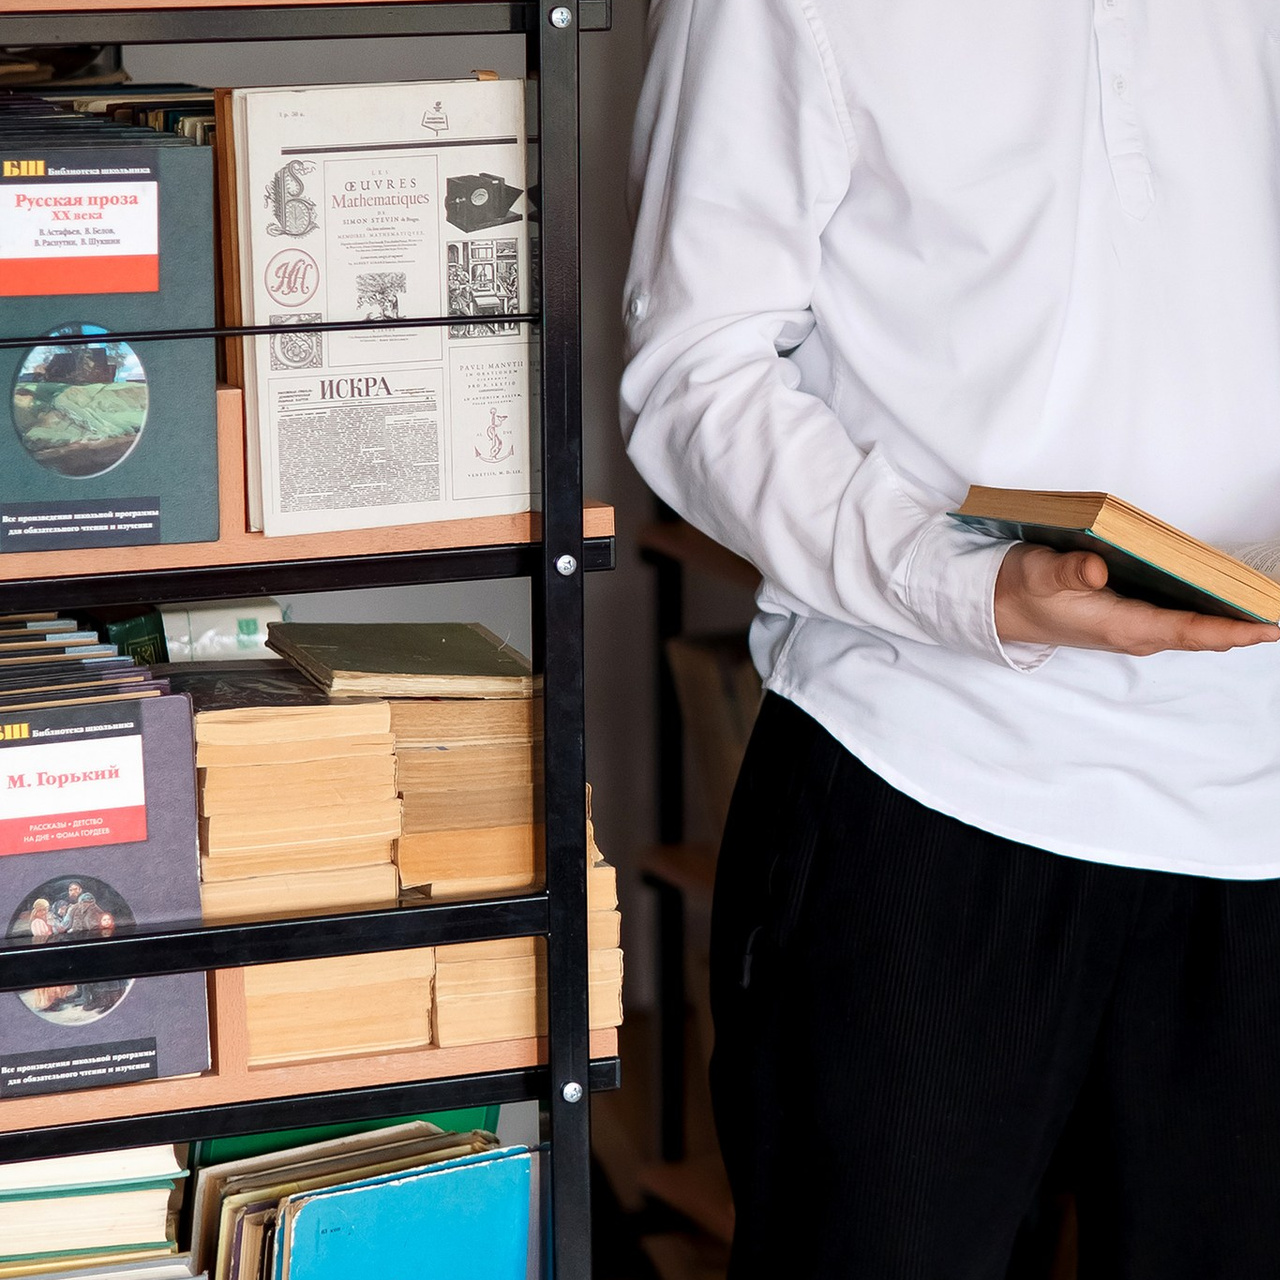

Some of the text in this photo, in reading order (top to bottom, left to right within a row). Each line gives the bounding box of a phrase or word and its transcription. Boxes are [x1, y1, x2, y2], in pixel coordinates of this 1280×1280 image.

[3, 160, 46, 177] БШ
[48, 167, 151, 176] Библиотека школьника
[344, 177, 417, 192] ŒUVRES
[15, 193, 139, 211] Русская проза
[331, 192, 430, 209] Mathematiques
[74, 210, 103, 221] века
[371, 216, 400, 224] STEVIN
[319, 376, 393, 400] ИСКРА
[0, 723, 30, 740] Ш
[32, 721, 134, 738] Библиотека школьника
[7, 764, 120, 789] М. Горький
[29, 817, 104, 831] РАССКАЗЫ ДЕТСТВО
[23, 827, 110, 843] НА ДНЕ ФОМА ГОРДЕЕВ
